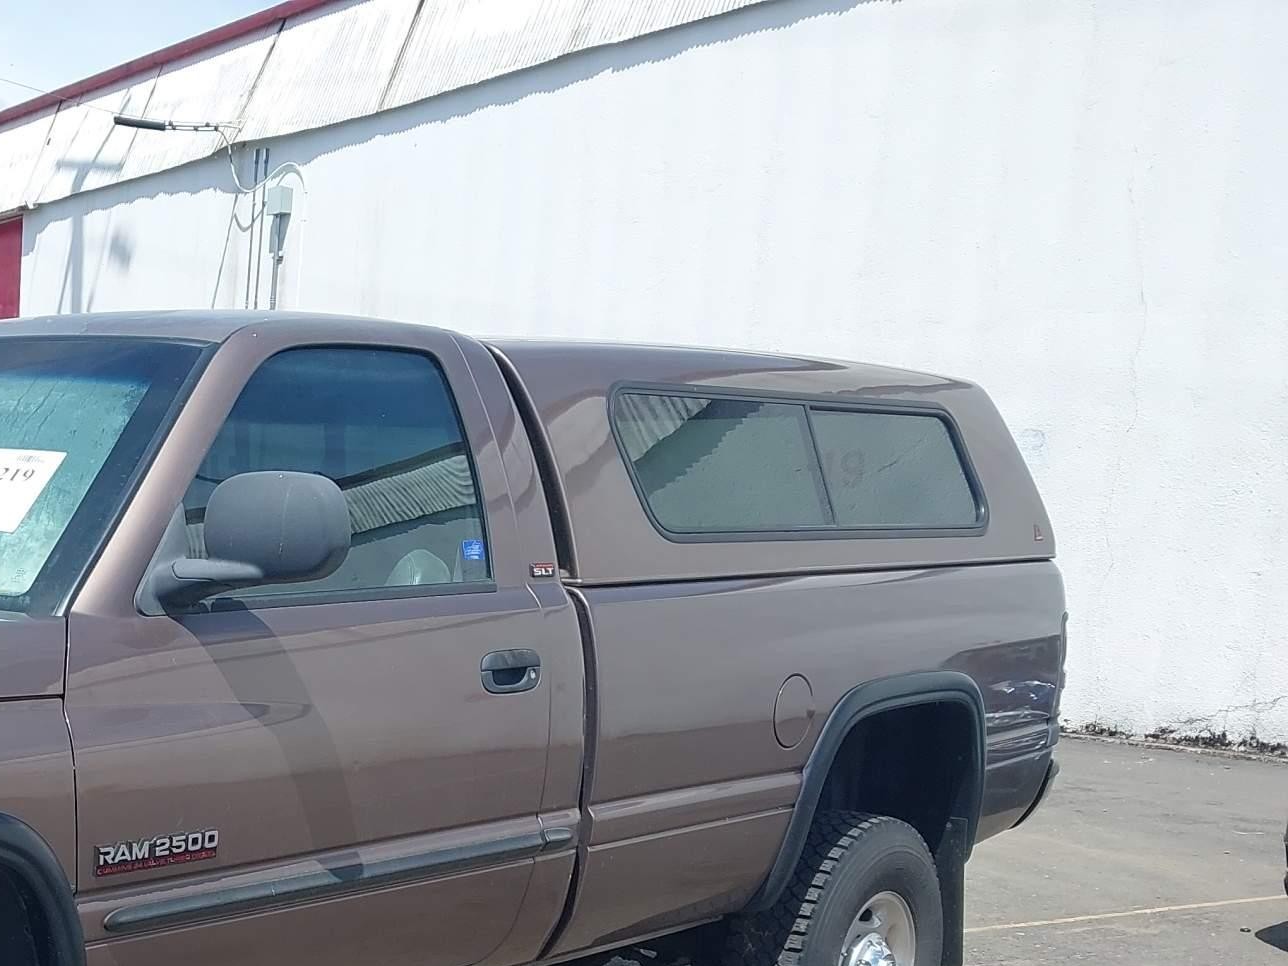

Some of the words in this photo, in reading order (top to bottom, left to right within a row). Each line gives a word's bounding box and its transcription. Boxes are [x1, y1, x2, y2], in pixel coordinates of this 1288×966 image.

[533, 567, 554, 576] SLT
[99, 841, 151, 866] RAM
[154, 830, 219, 857] 2500
